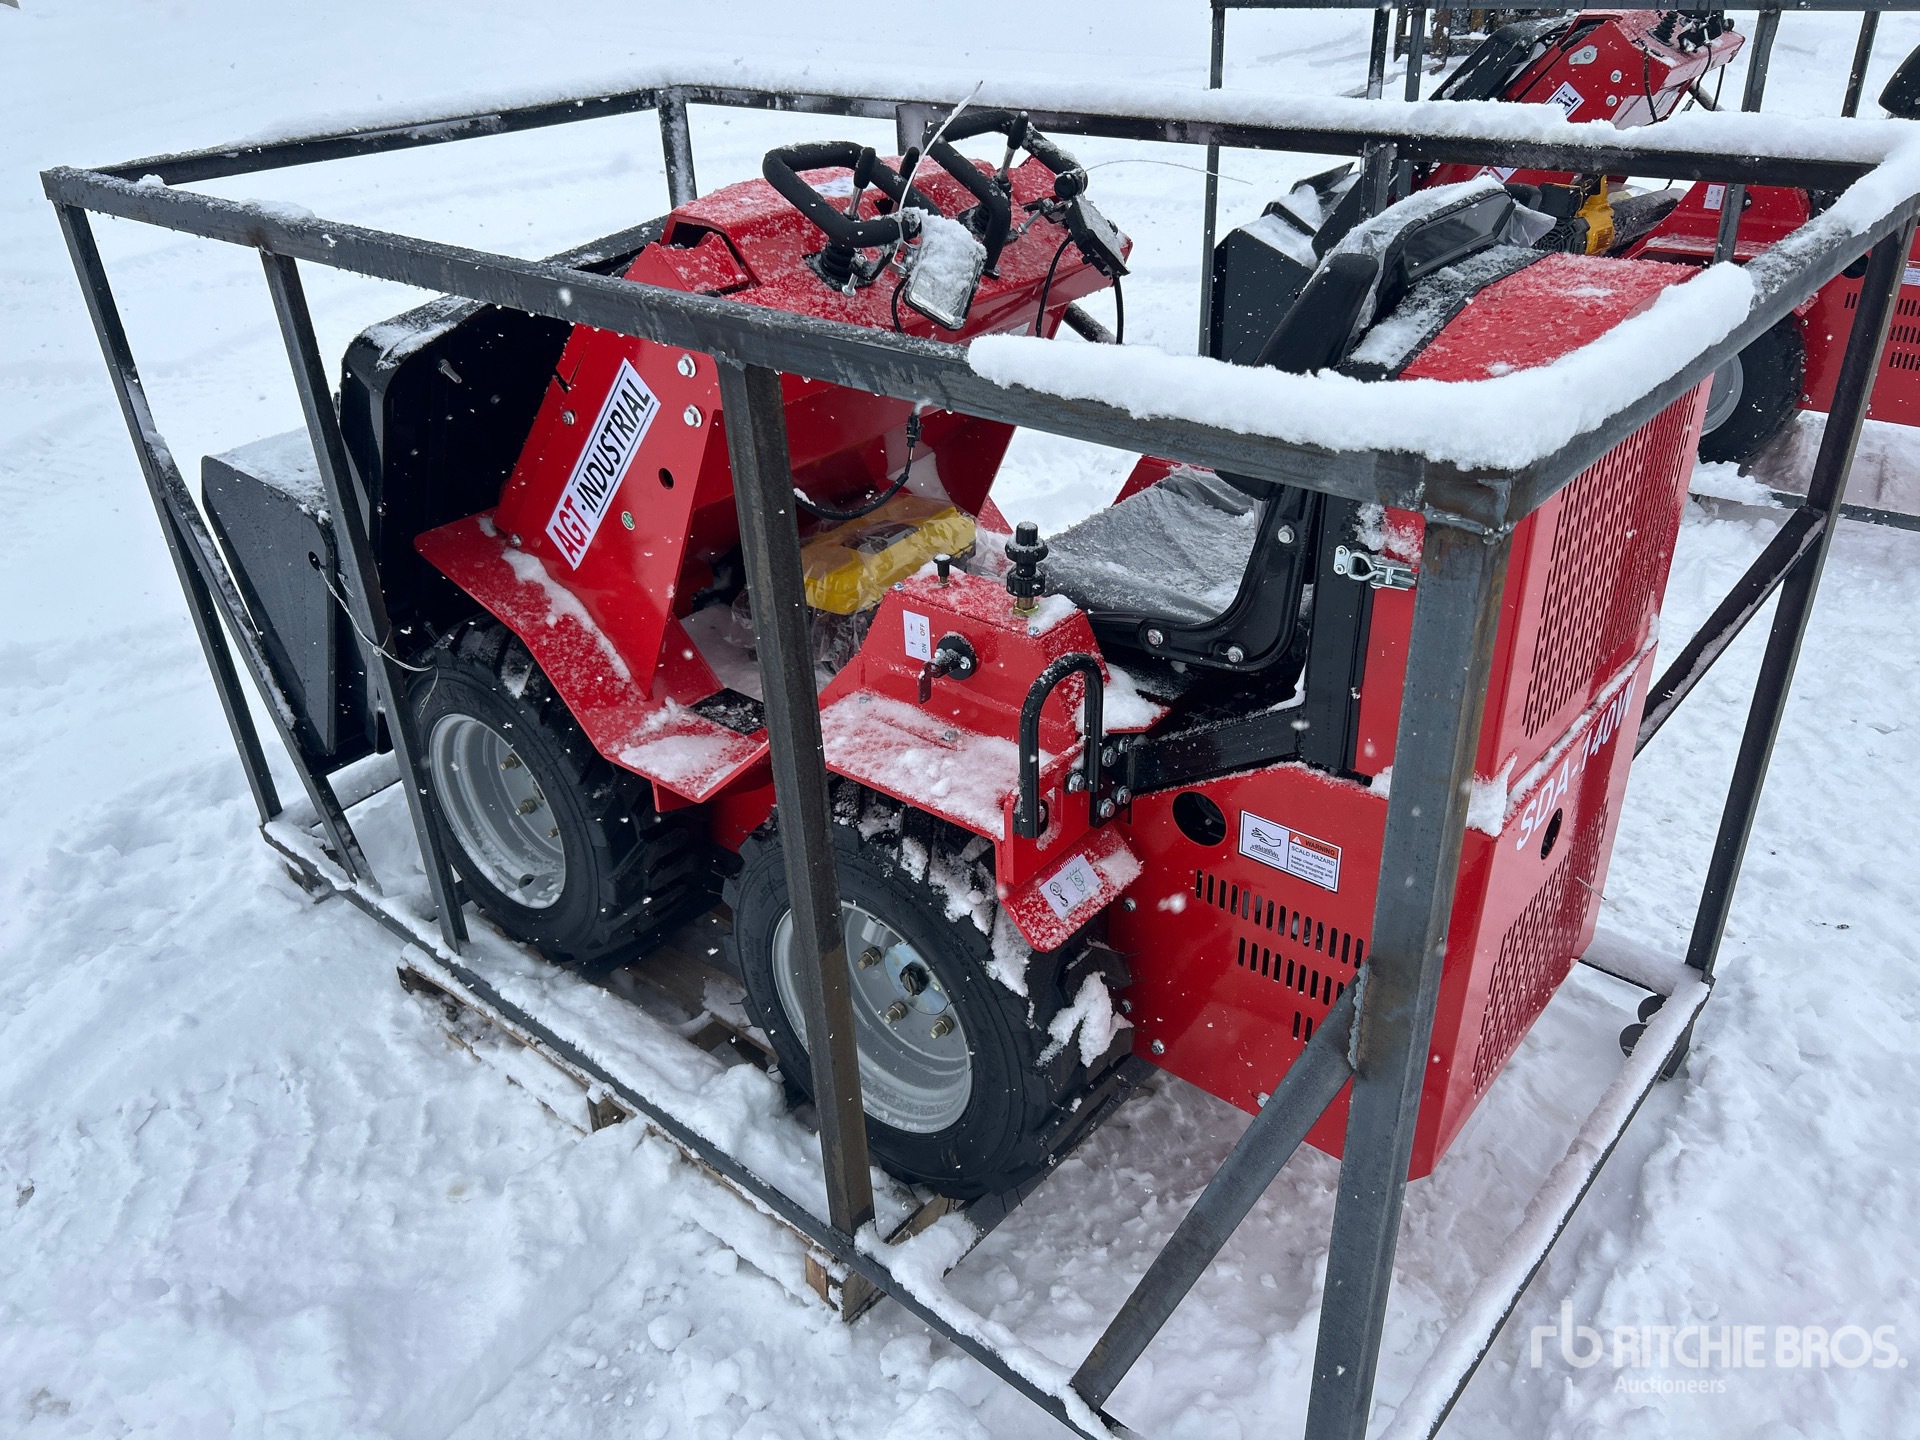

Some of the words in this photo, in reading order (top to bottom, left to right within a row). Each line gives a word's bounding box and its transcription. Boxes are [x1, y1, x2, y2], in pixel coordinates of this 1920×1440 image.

[553, 495, 592, 564] AGT
[921, 643, 927, 654] ON
[1291, 845, 1311, 857] SCALD
[1311, 854, 1335, 866] HAZARD
[1305, 840, 1335, 856] WARNING
